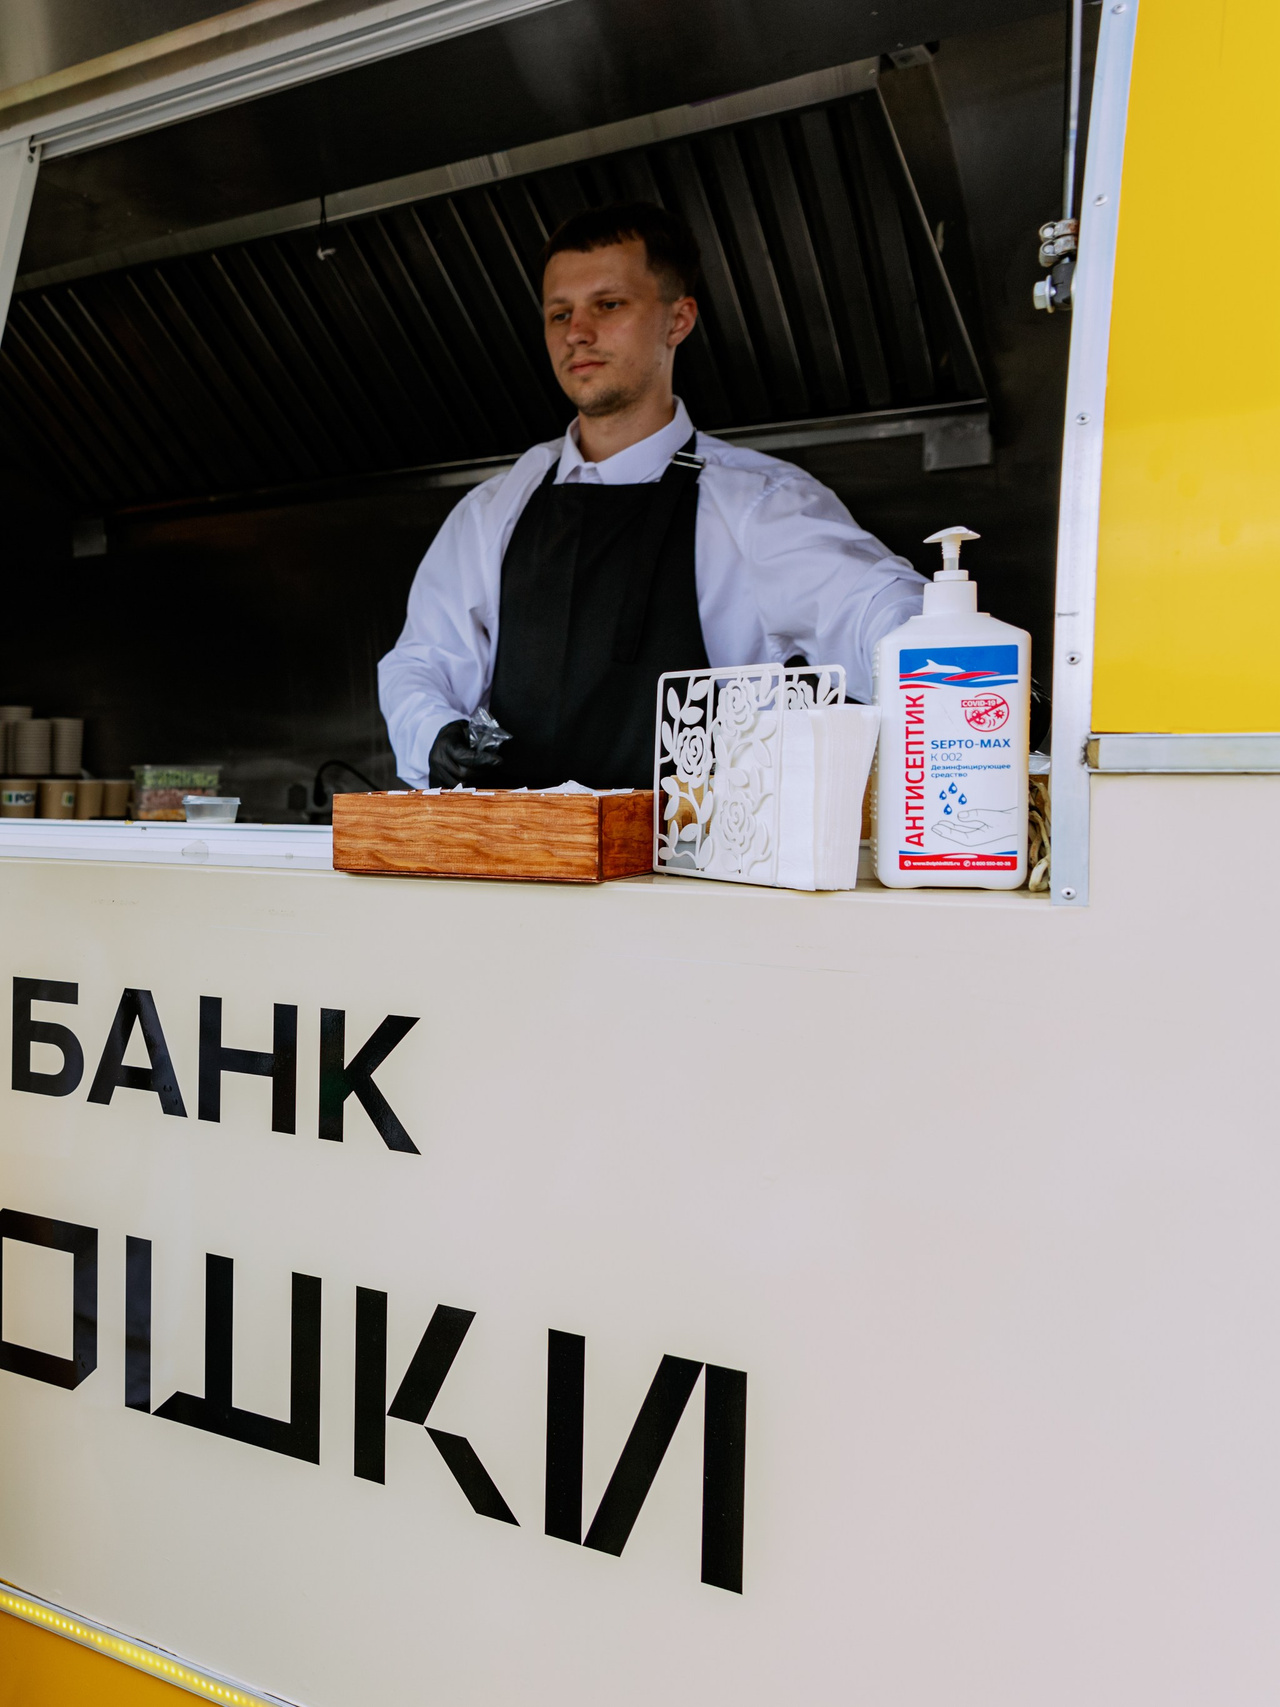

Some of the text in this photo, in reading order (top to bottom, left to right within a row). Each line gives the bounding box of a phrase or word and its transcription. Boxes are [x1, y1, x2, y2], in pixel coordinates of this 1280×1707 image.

[962, 700, 997, 708] COVID-19
[930, 738, 1011, 750] SEPTO-MAX
[941, 752, 963, 762] 002
[905, 694, 925, 847] АНТИСЕПТИК
[930, 763, 1011, 772] Дезинфицирующее
